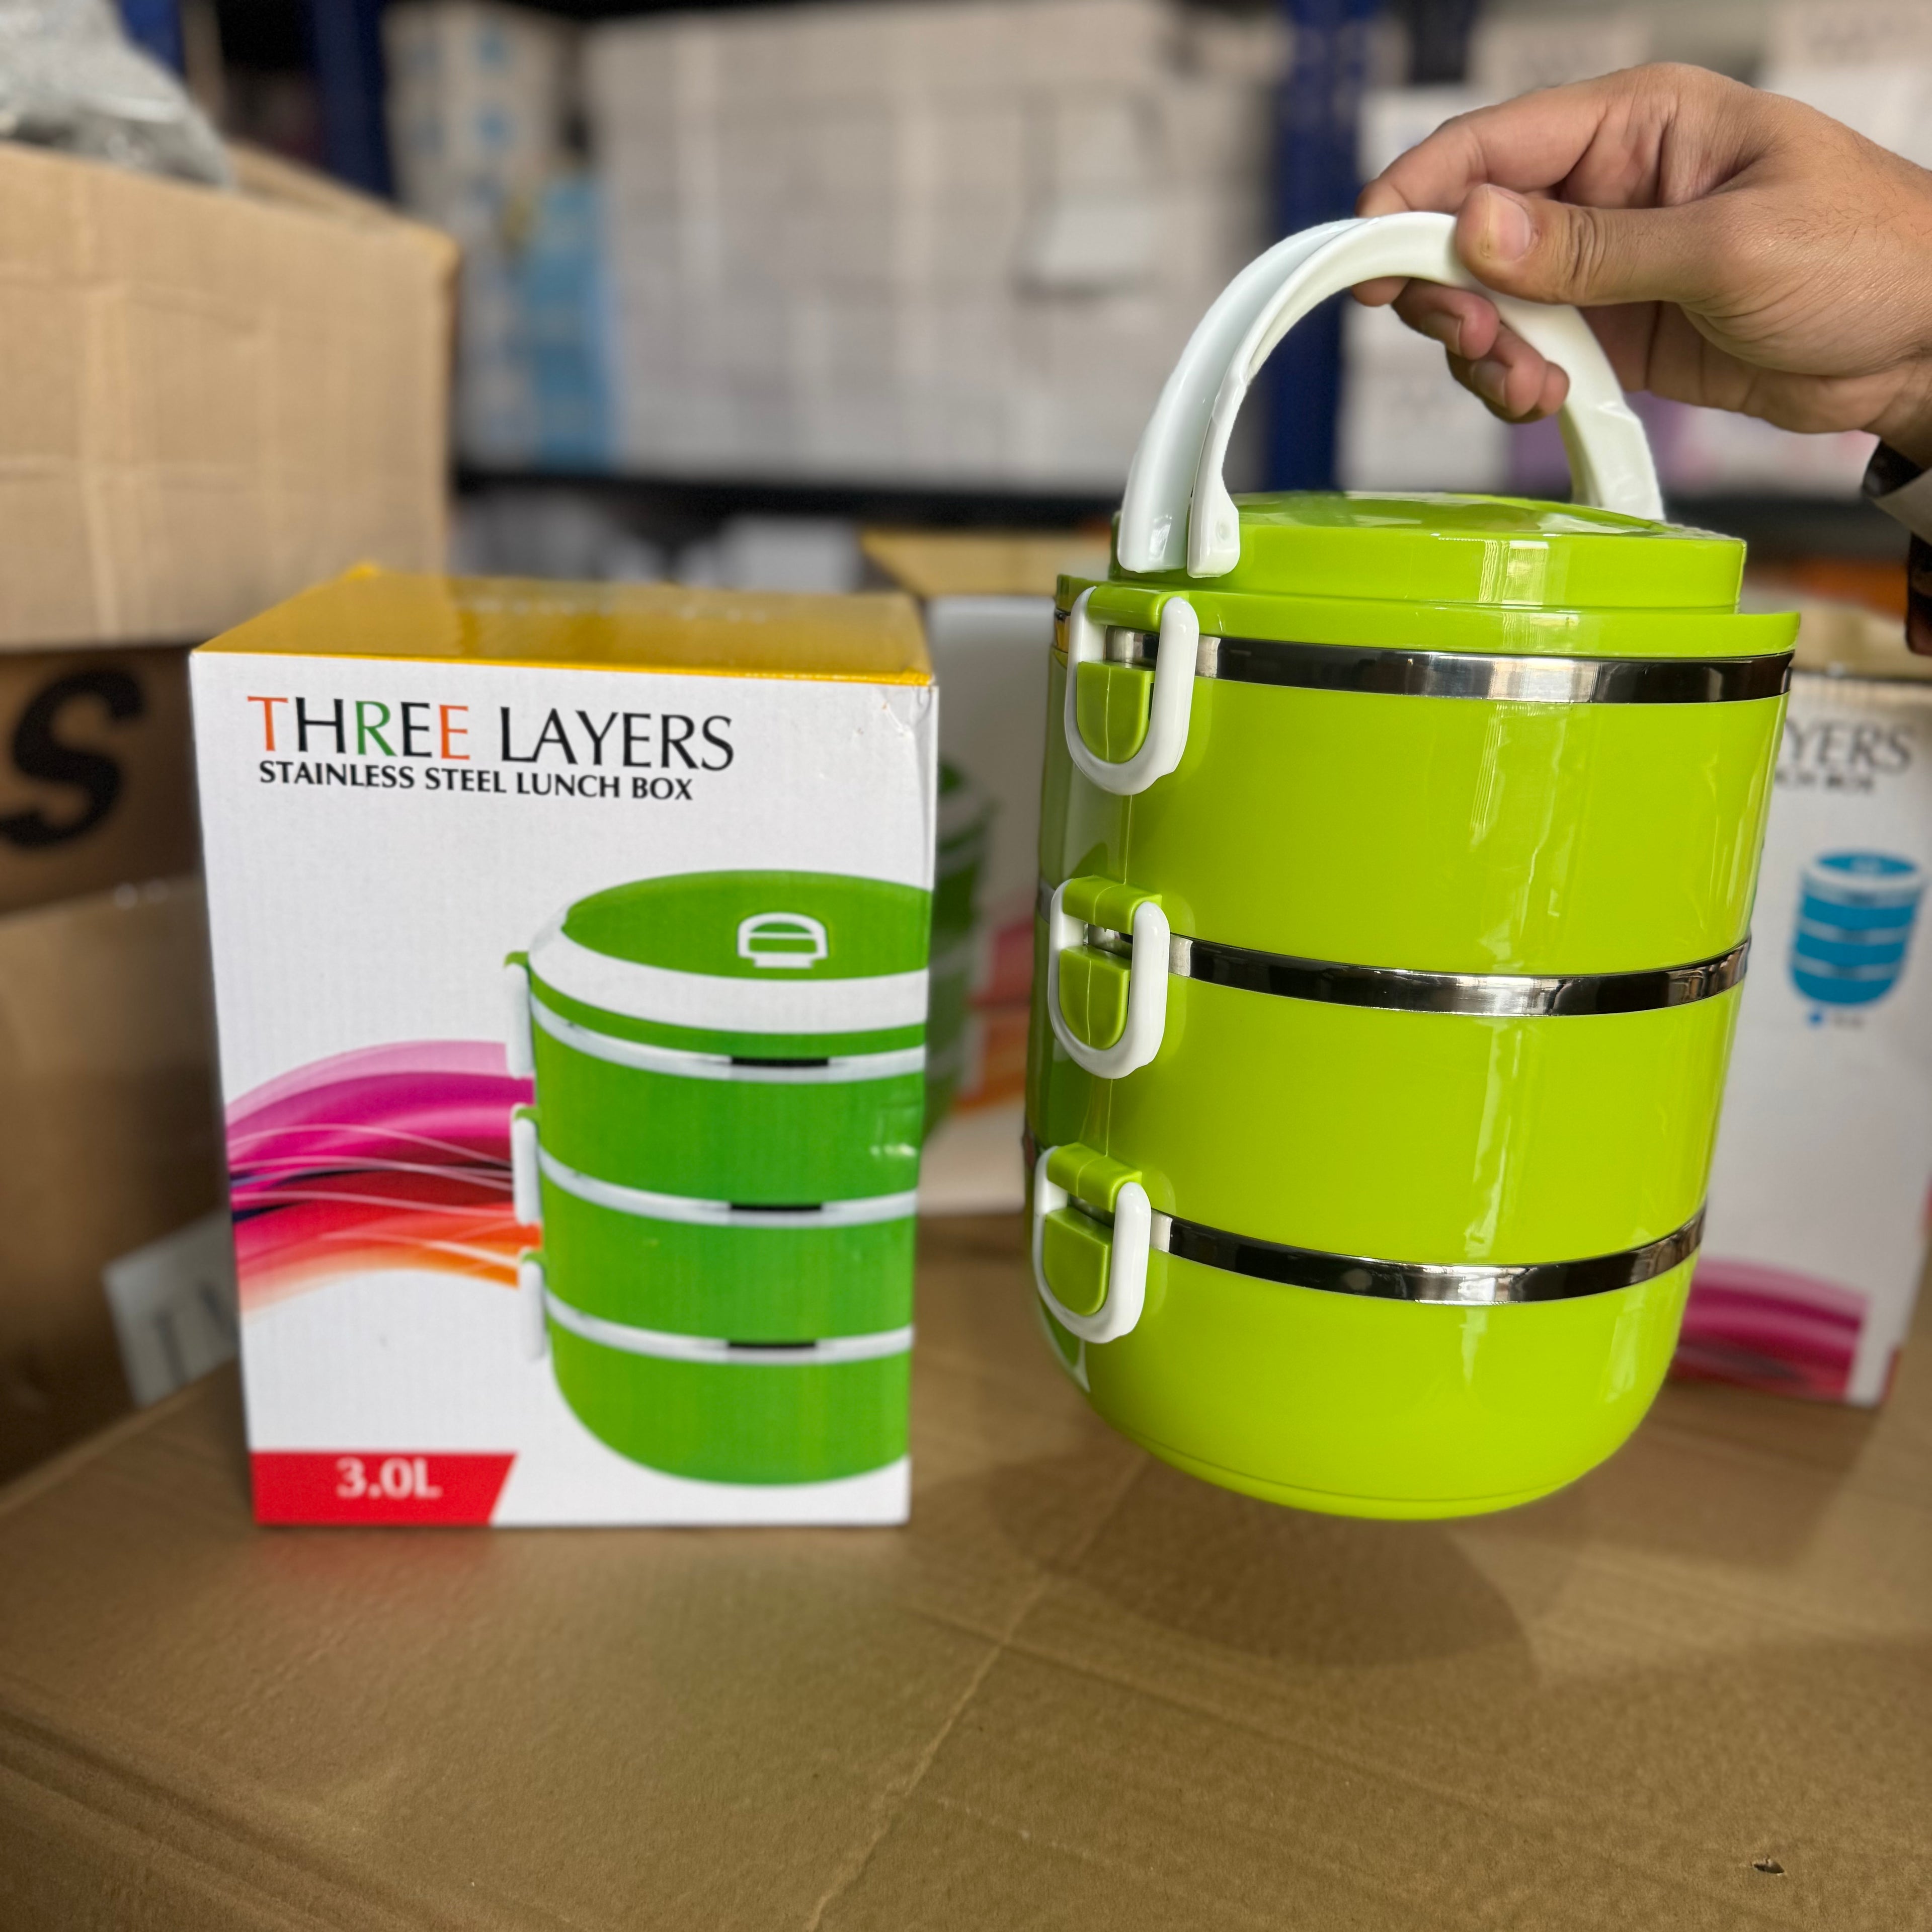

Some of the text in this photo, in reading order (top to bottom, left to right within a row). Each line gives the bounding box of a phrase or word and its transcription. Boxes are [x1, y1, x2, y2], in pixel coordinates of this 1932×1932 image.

[247, 696, 734, 771] THREE LAYERS
[259, 760, 692, 800] STAINLESS STEEL LUNCH BOX
[337, 1457, 441, 1499] 3.0L
